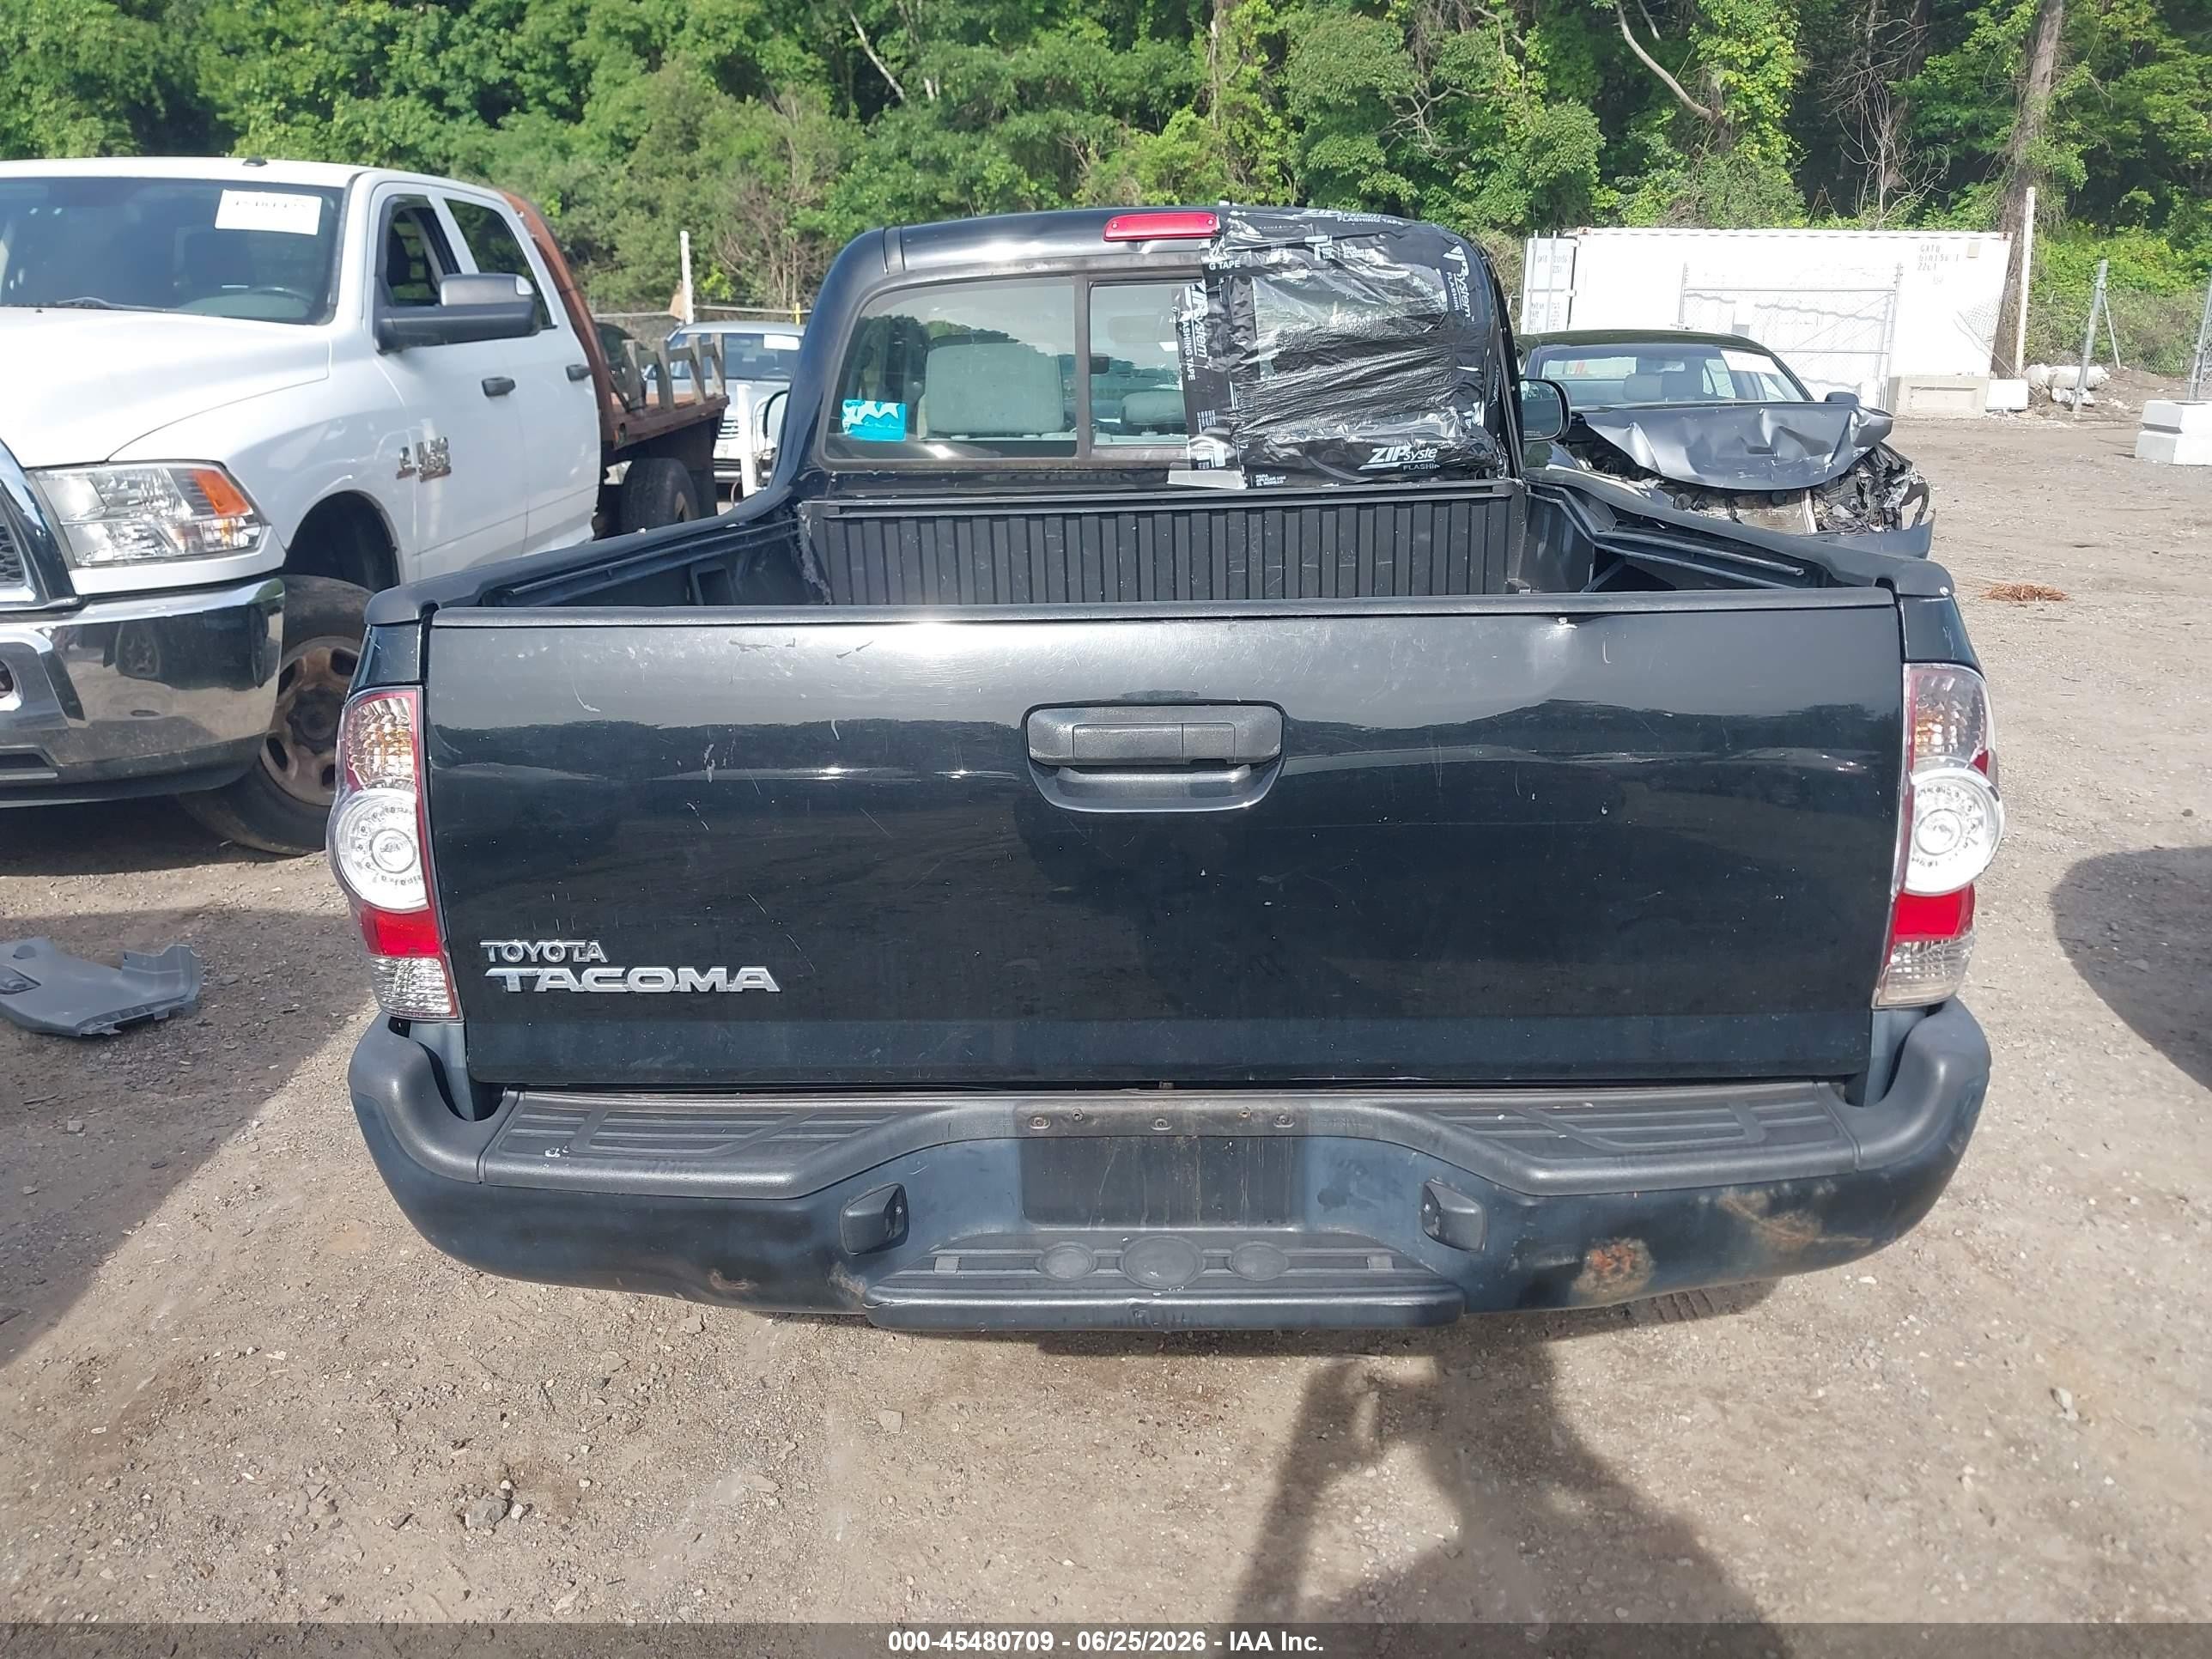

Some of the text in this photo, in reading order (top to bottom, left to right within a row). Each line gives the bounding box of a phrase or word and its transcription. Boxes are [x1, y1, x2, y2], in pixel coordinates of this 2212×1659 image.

[1208, 260, 1241, 270] G TAPE
[1186, 357, 1196, 381] TAPE
[479, 939, 609, 963] TOYOTA
[484, 966, 783, 993] TACOMA
